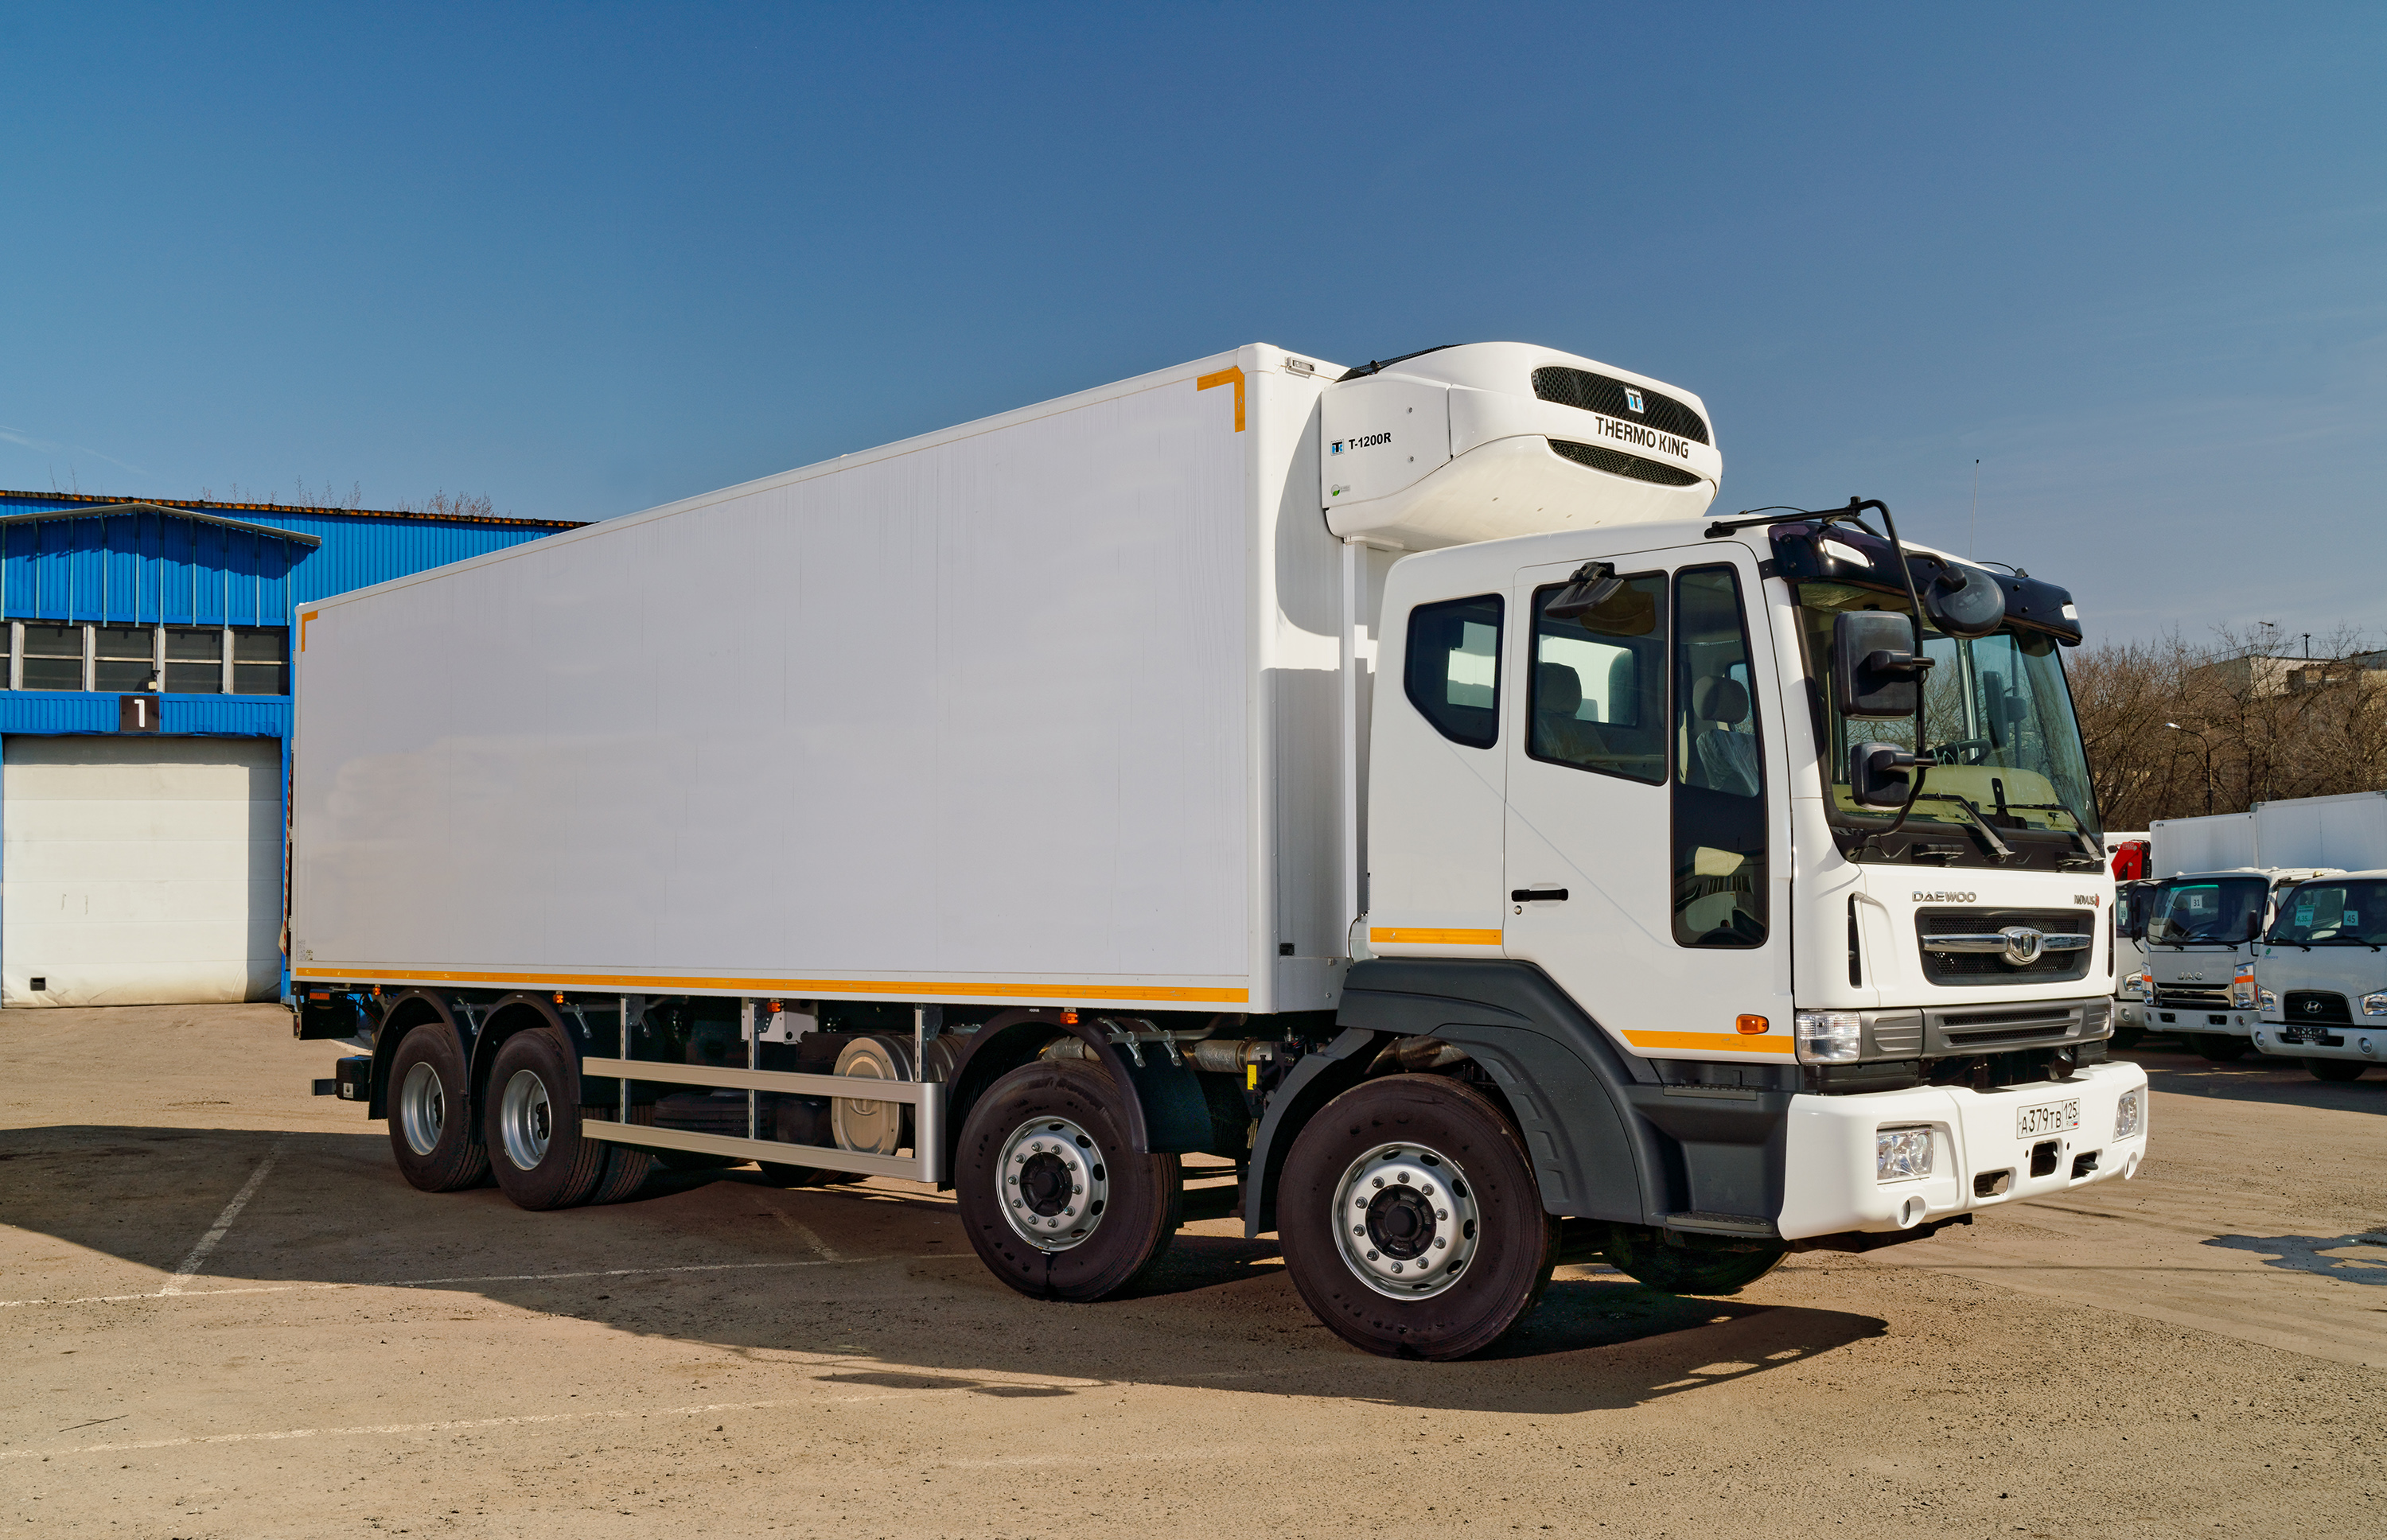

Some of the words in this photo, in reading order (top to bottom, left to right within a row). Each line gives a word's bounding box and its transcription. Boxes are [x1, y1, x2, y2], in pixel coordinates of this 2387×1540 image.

[1348, 432, 1392, 450] T-1200R
[1595, 416, 1656, 448] THERMO
[1658, 434, 1688, 459] KING
[134, 699, 145, 728] 1
[1912, 891, 1976, 903] DAEWOO
[2177, 971, 2203, 981] JAC
[2063, 1101, 2077, 1120] 125
